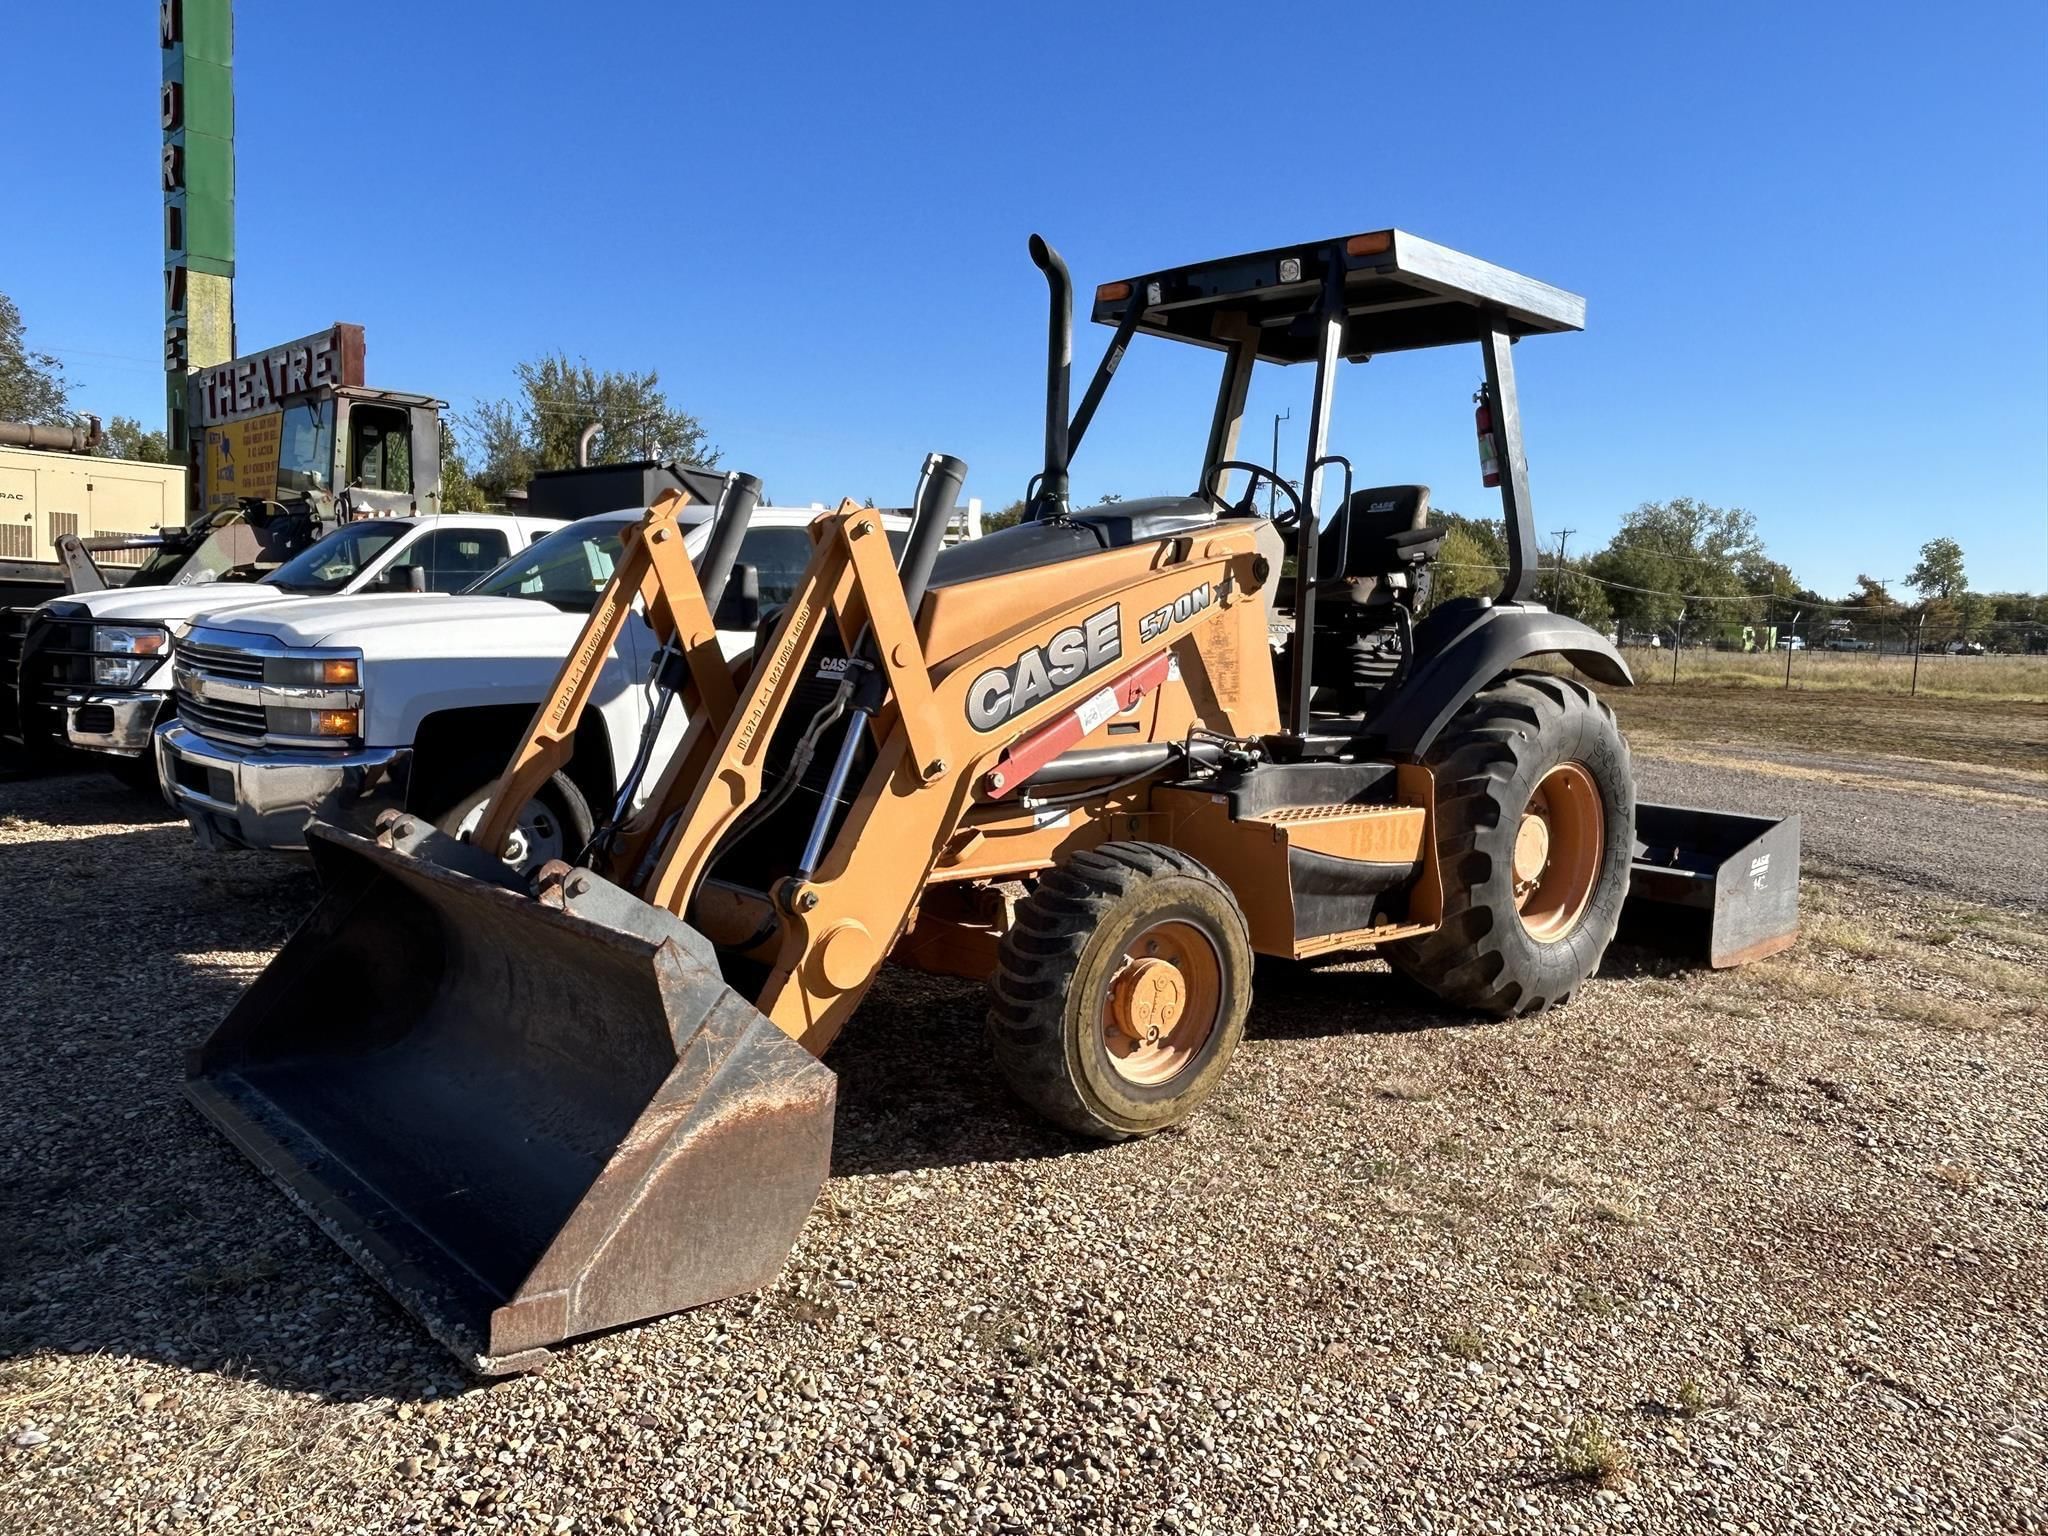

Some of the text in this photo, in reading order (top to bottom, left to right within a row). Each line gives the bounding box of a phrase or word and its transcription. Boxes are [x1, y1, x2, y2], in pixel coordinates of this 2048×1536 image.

[160, 81, 187, 371] DRIVE
[200, 336, 338, 420] THEATRE
[1139, 581, 1210, 644] 570N
[820, 657, 848, 671] CAS
[965, 602, 1122, 733] CASE
